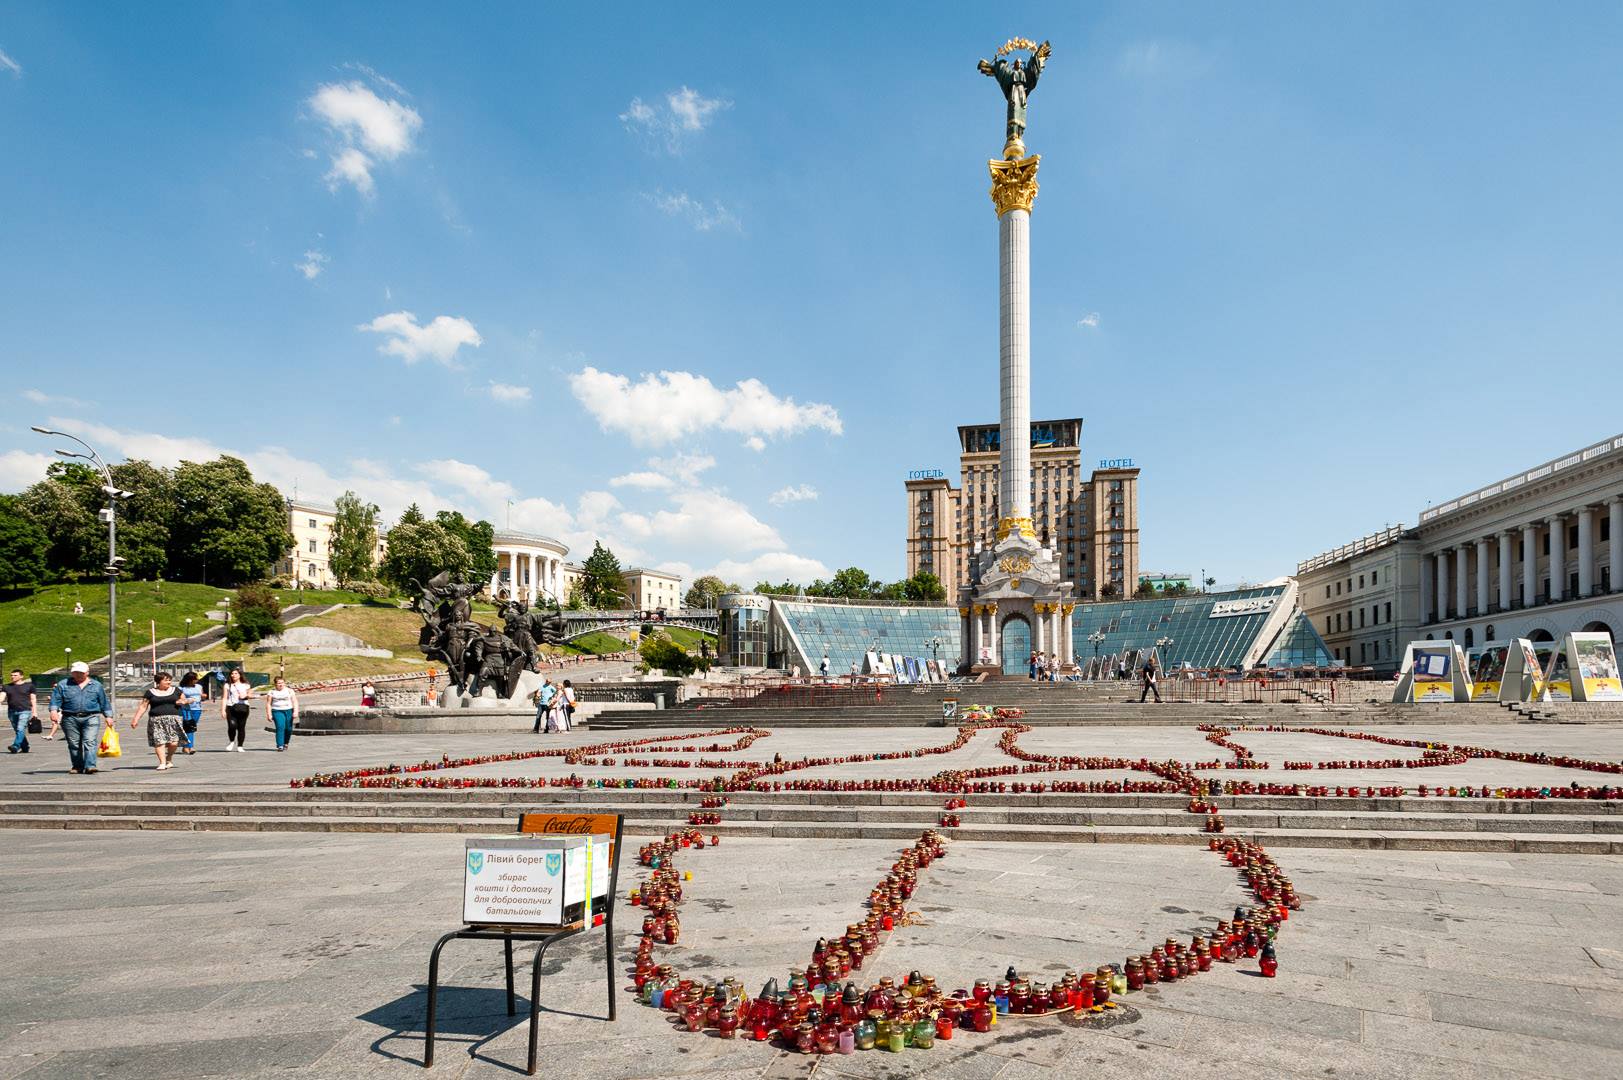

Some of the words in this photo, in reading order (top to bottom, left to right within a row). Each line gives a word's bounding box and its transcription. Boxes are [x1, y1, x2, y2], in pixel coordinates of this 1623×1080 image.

[1100, 459, 1135, 468] HOTEL
[909, 469, 944, 479] ГОТЕЛЬ
[544, 816, 596, 834] Coca-Cola
[487, 854, 514, 864] Лівий
[516, 854, 543, 866] берег
[498, 873, 528, 882] збирає
[474, 885, 504, 893] кошти
[511, 885, 553, 895] допомогу
[474, 895, 490, 904] для
[491, 896, 553, 906] добровольчих
[486, 906, 542, 916] батальйонів
